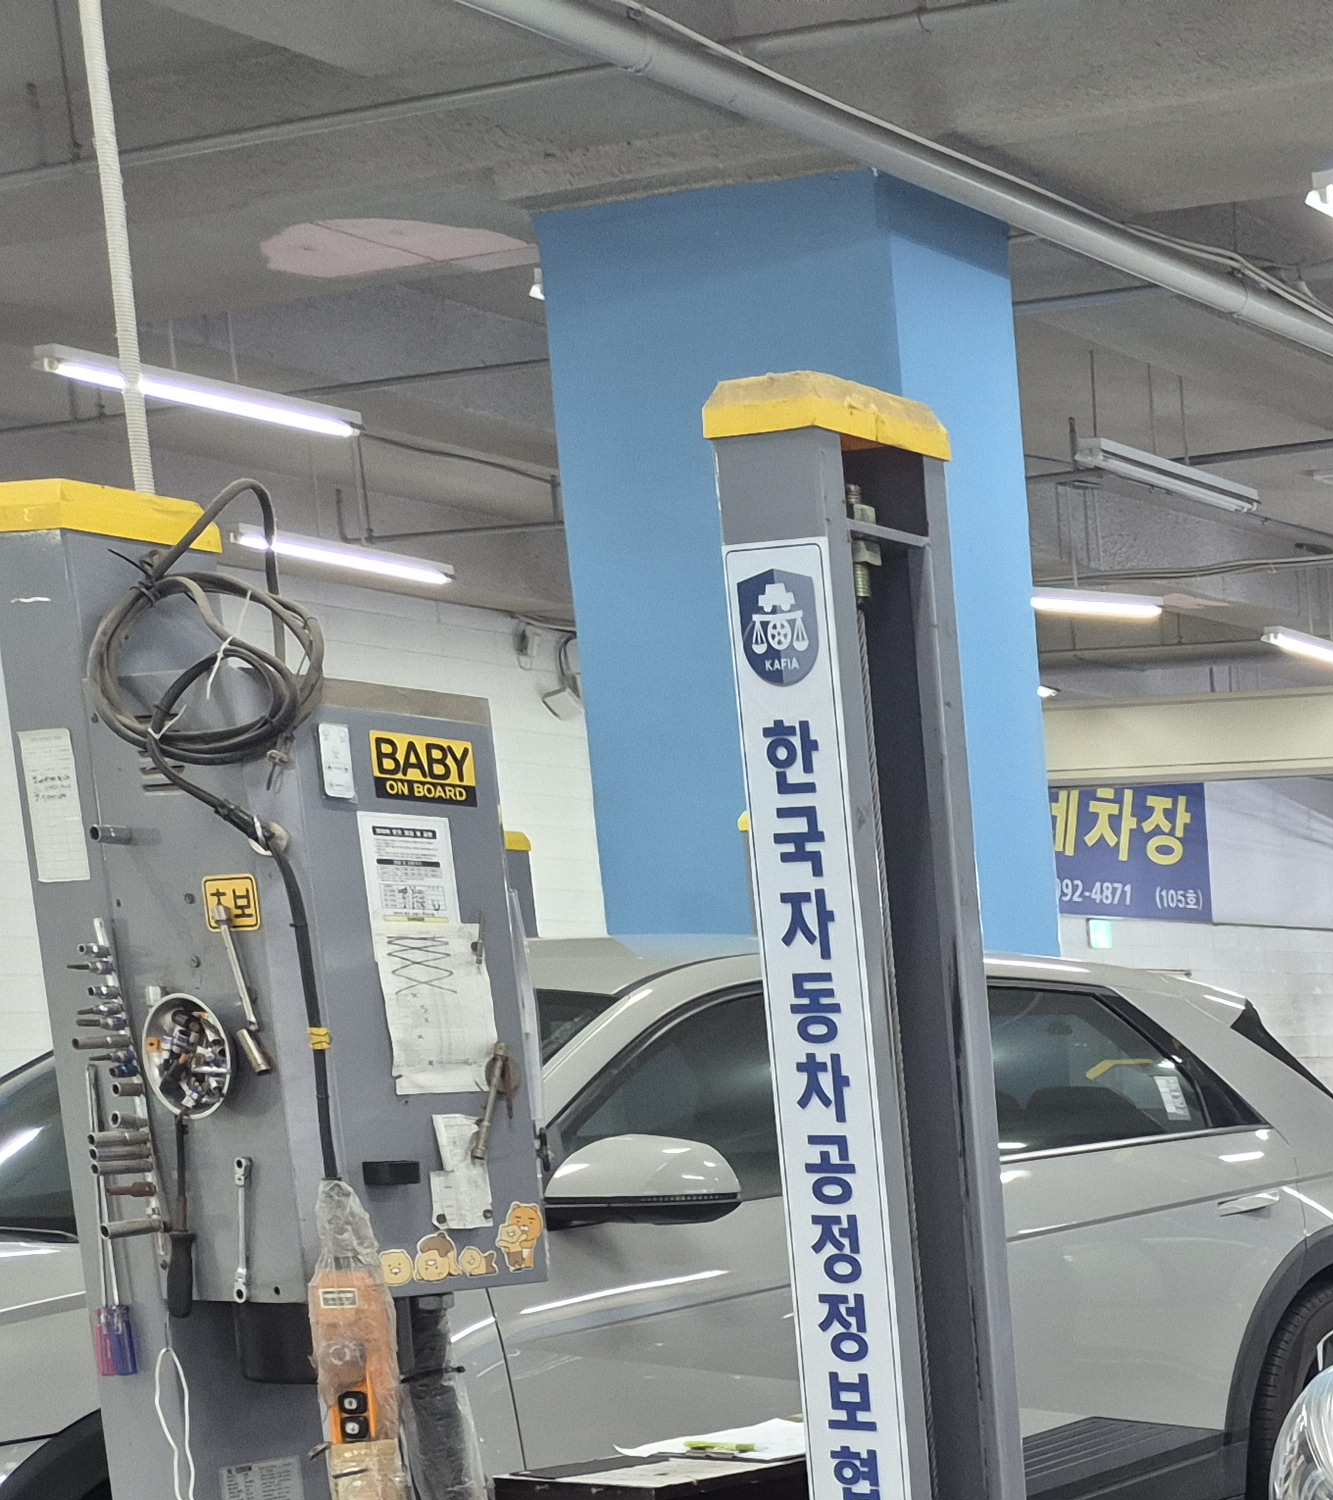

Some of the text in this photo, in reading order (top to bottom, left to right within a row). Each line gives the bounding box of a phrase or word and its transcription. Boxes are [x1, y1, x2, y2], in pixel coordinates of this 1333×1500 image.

[764, 657, 800, 671] KAFIA
[375, 736, 469, 783] BABY
[385, 780, 467, 801] ON BOARD
[1056, 877, 1203, 912] 92-4871 (105호)
